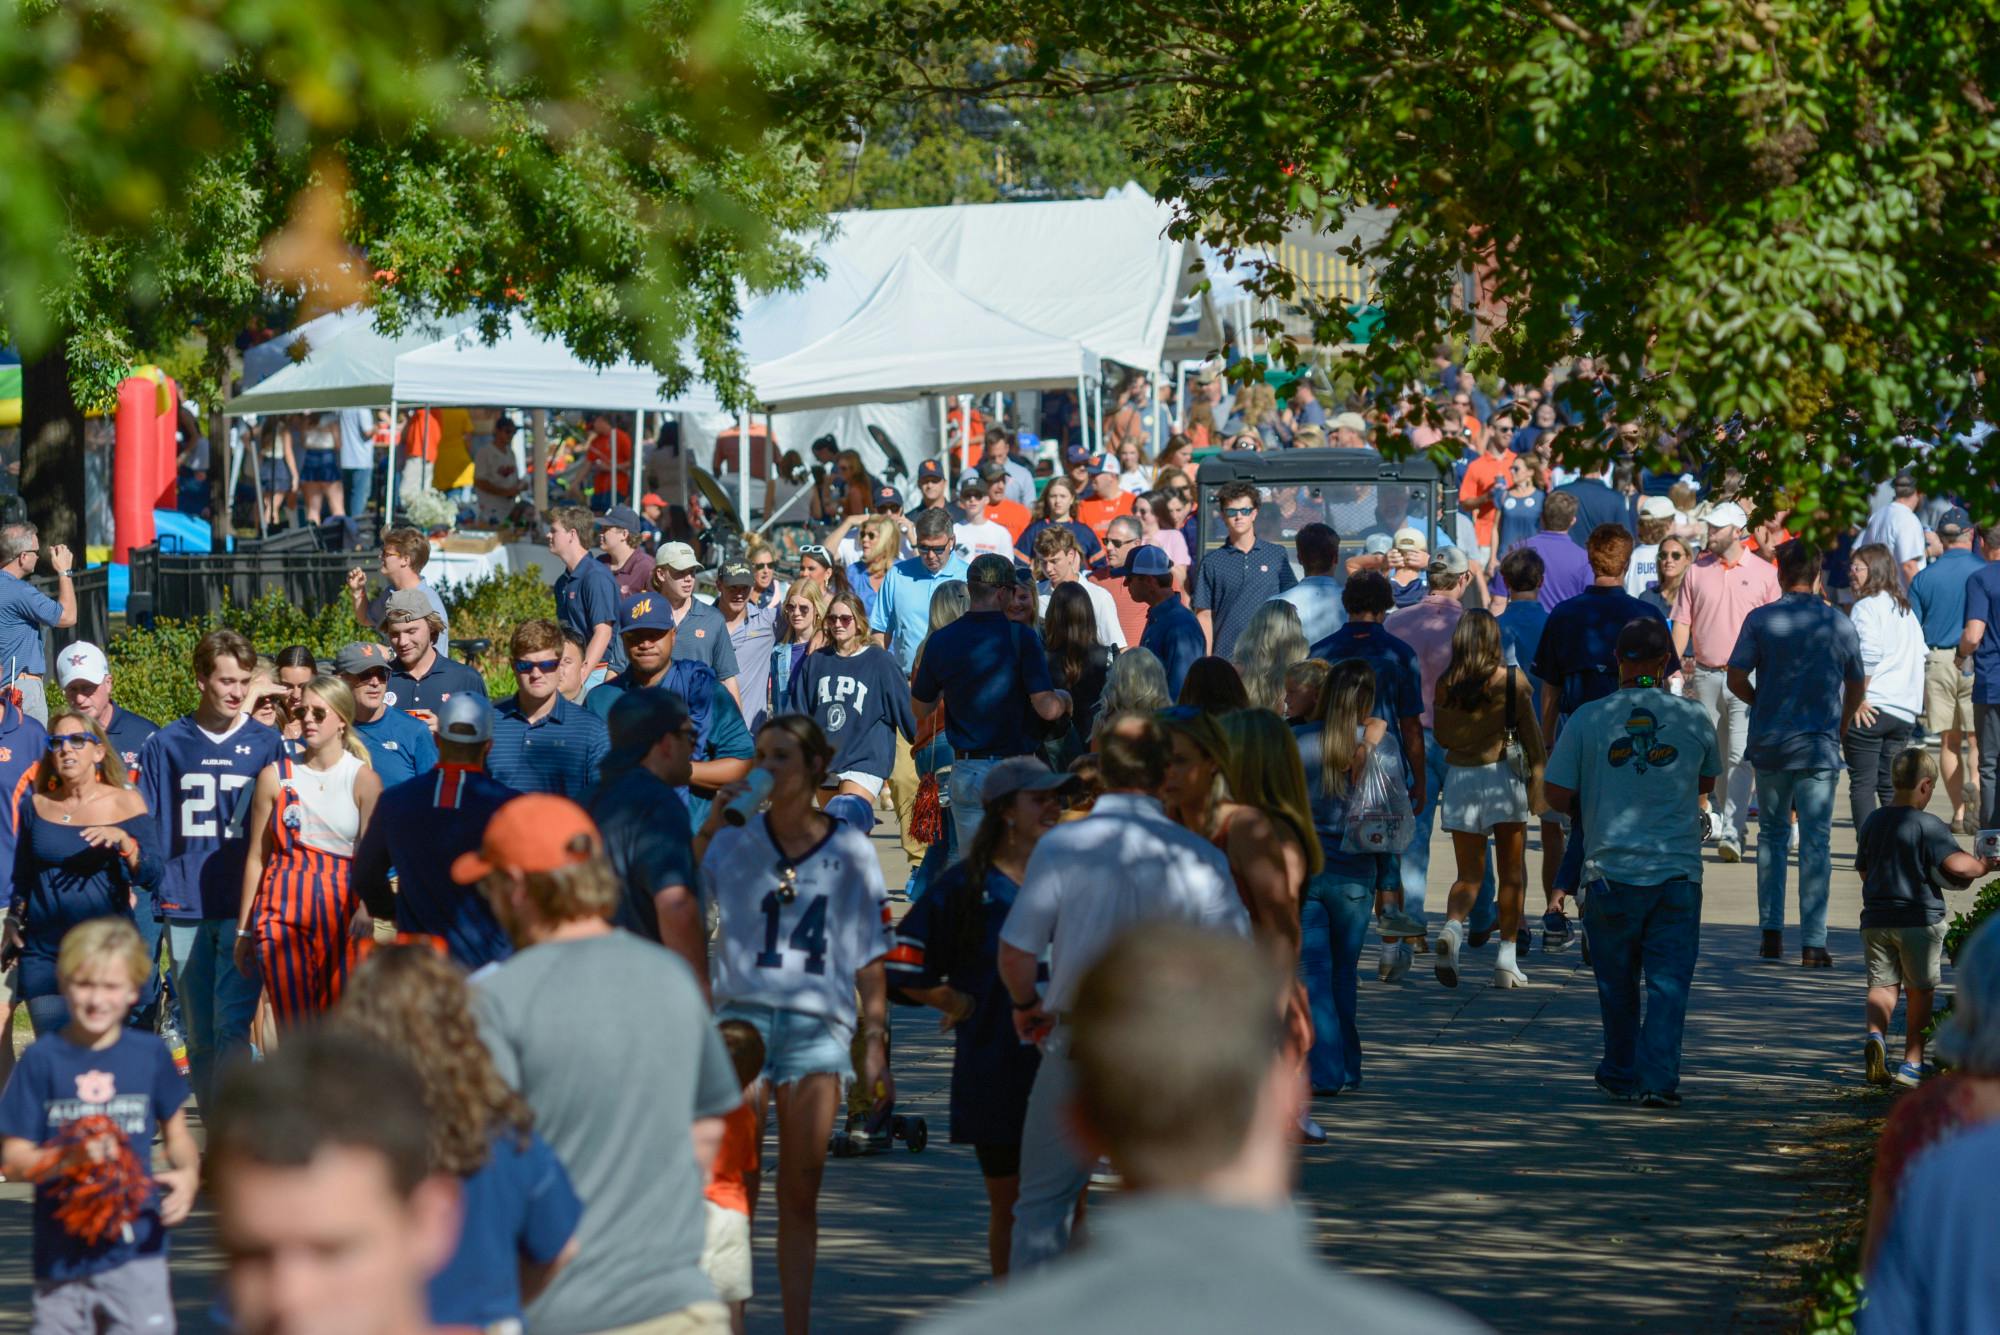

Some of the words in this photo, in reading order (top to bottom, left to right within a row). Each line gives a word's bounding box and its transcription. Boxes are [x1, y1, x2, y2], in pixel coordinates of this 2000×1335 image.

[818, 676, 868, 715] API
[181, 773, 253, 838] 27
[756, 890, 828, 976] 14
